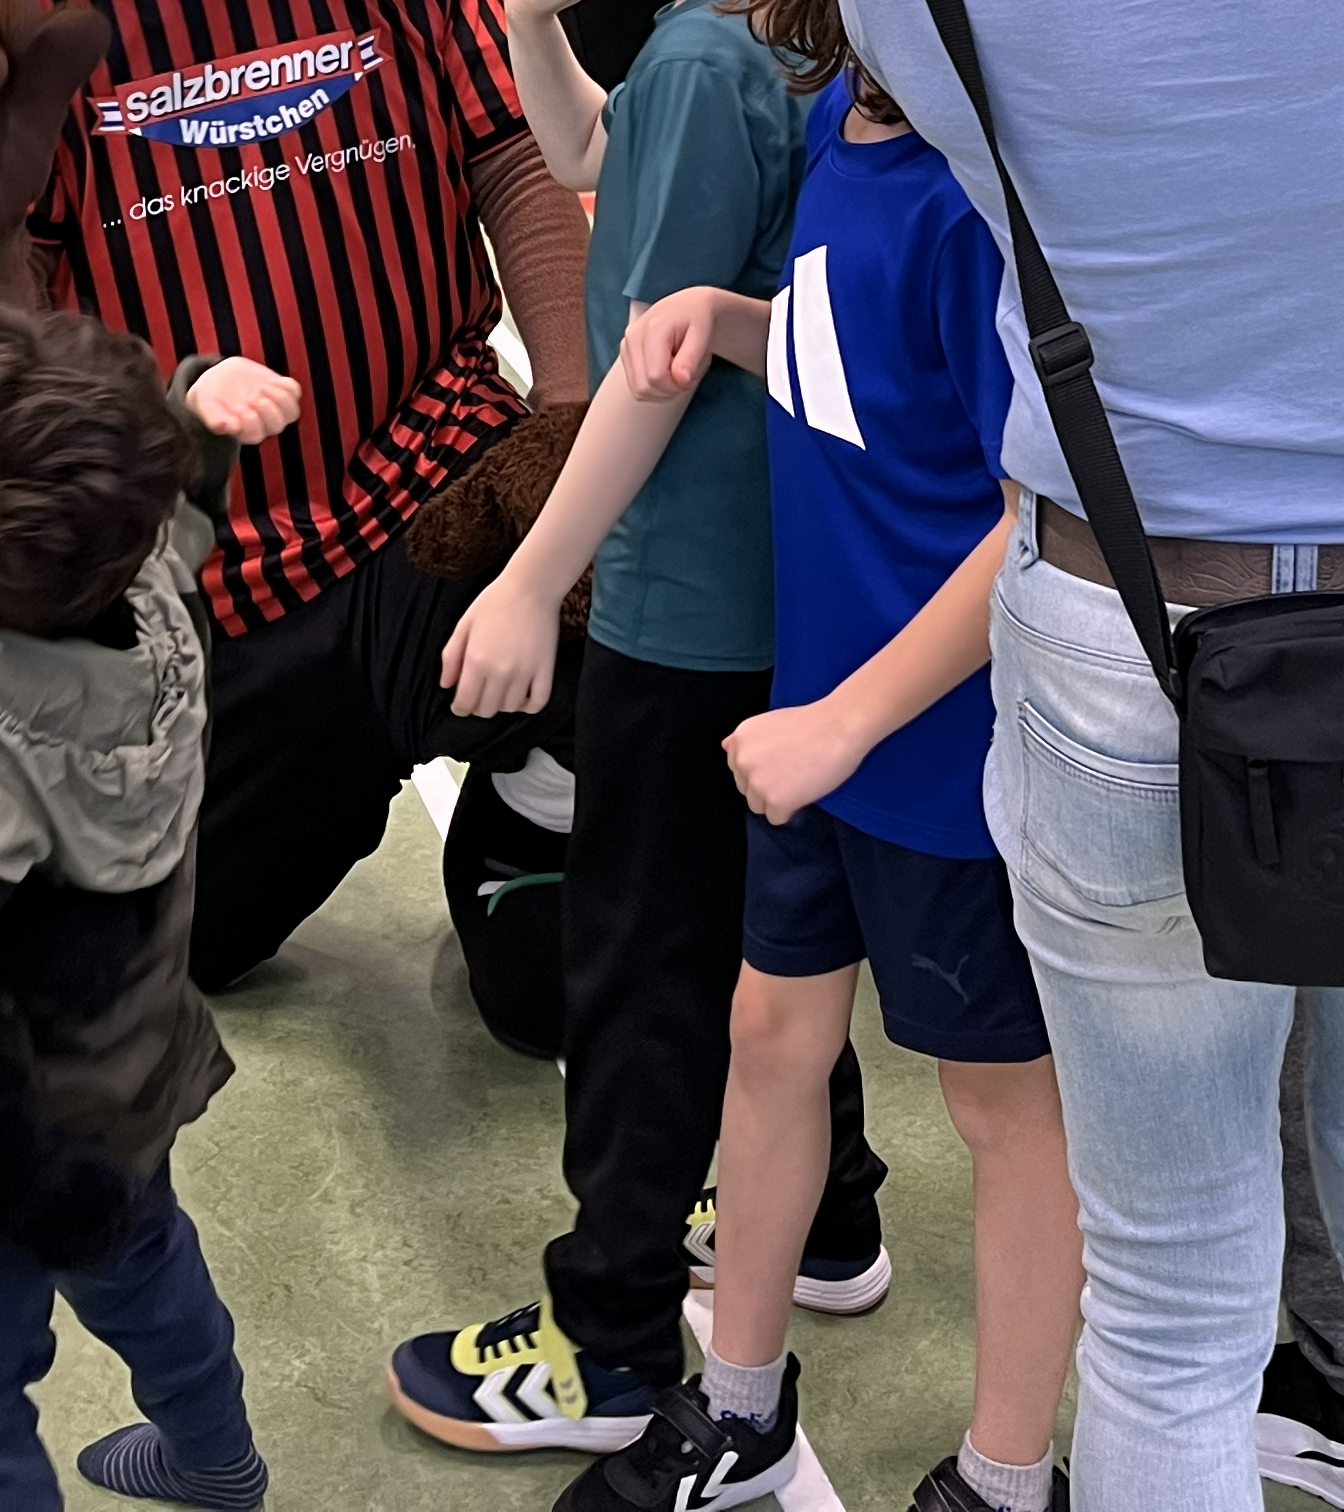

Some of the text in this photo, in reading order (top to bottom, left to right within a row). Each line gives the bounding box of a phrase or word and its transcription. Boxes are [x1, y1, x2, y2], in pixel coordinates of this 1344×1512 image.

[125, 39, 354, 123] salzbrenner
[179, 87, 332, 146] Würstchen
[128, 190, 176, 222] das
[179, 162, 292, 208] knackige
[294, 131, 417, 177] Vergnügen.
